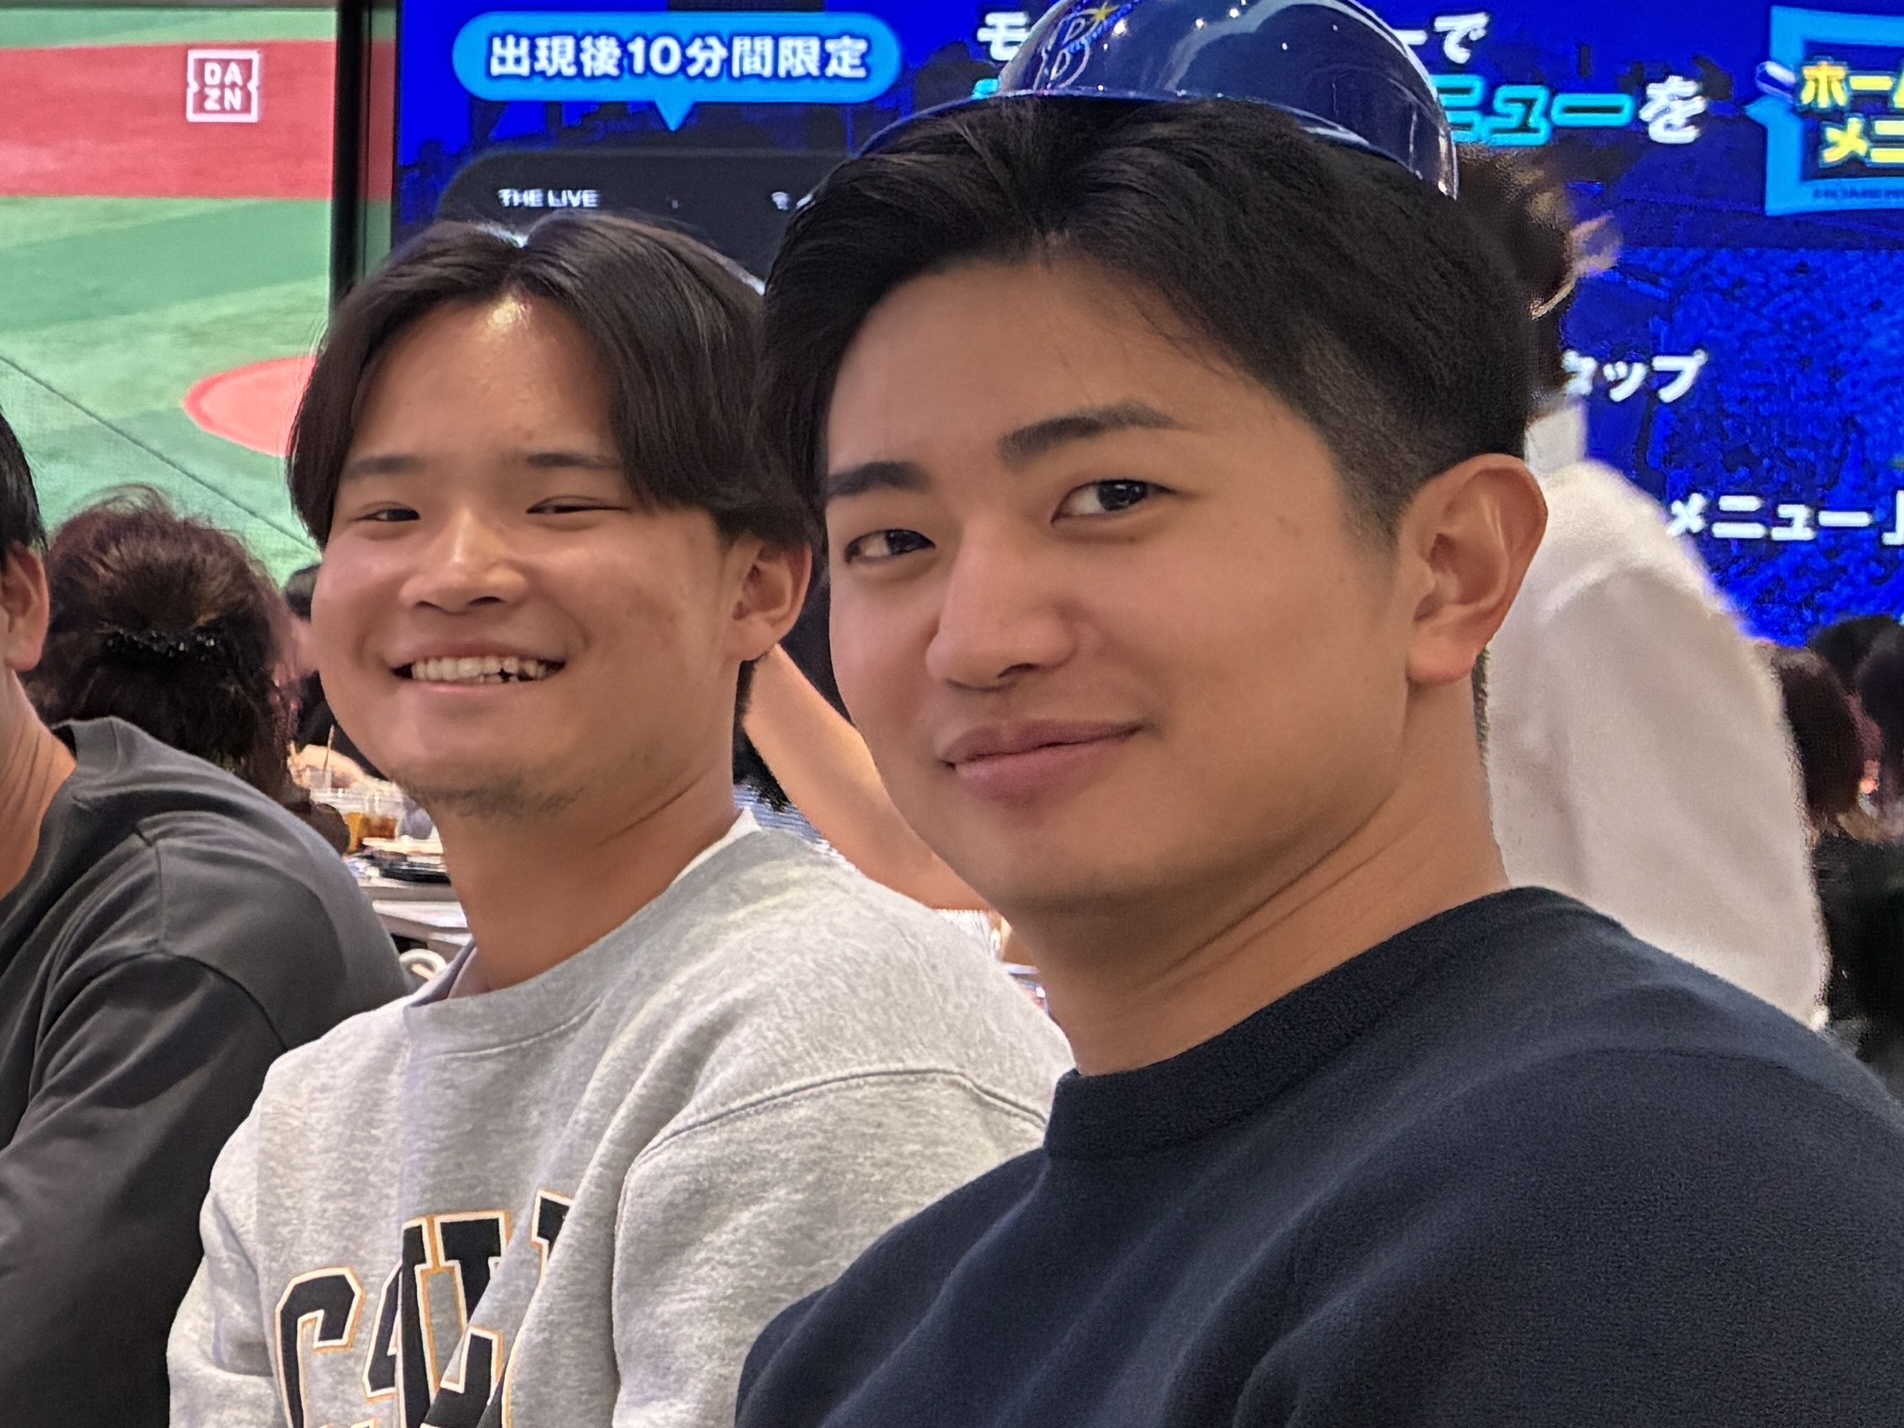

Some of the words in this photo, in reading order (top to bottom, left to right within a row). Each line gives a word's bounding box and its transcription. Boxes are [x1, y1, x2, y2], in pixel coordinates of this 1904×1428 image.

[490, 34, 869, 79] 出現後10分間限定
[498, 188, 544, 208] THE
[547, 188, 599, 208] LIVE
